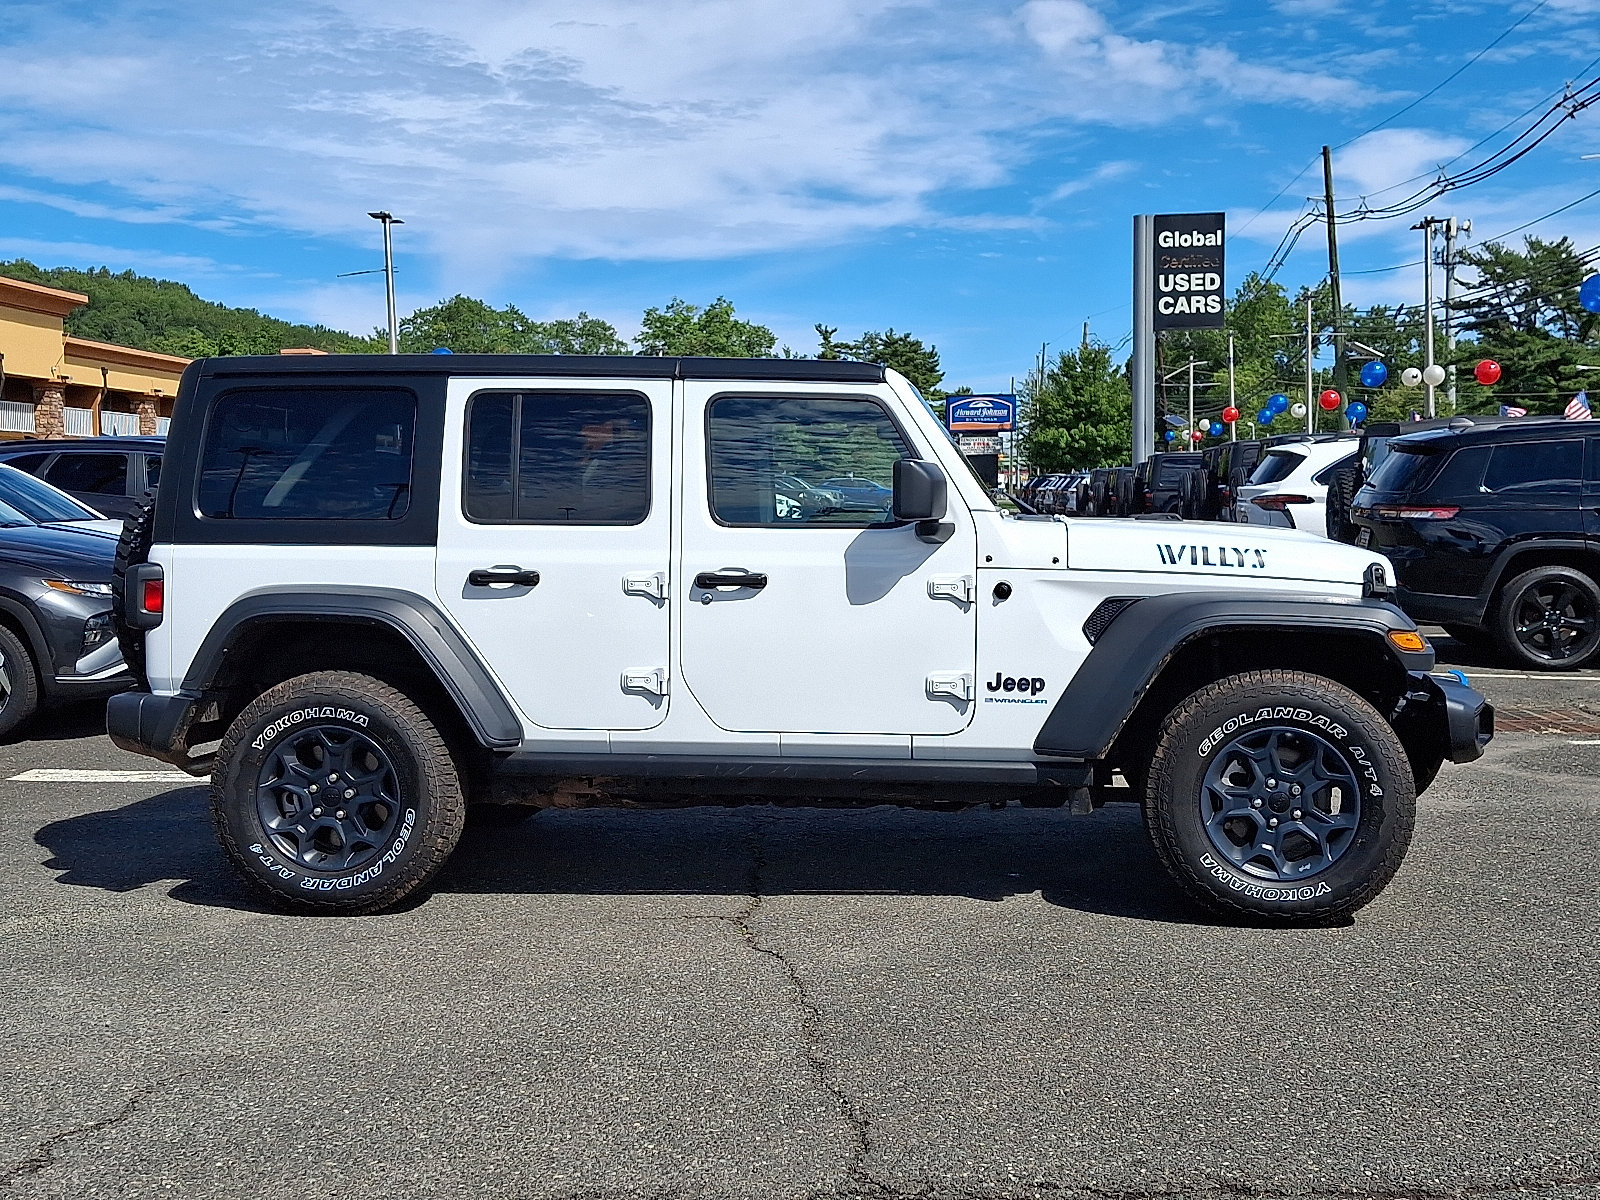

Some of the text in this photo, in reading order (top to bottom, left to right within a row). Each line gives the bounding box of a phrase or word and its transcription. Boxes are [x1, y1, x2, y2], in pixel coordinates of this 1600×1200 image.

[1158, 229, 1222, 248] Global
[1158, 272, 1221, 292] USED
[1158, 294, 1221, 315] CARS
[954, 407, 1008, 418] Howard Johnson
[1156, 543, 1268, 569] WILLYS
[986, 671, 1046, 697] Jeep
[994, 697, 1048, 705] WRANGLER
[251, 706, 370, 751] YOKOHAMA
[1198, 706, 1348, 757] GEOLANDAR
[300, 807, 417, 891] GEOLANDAR
[1199, 852, 1332, 902] YOKOHAMA
